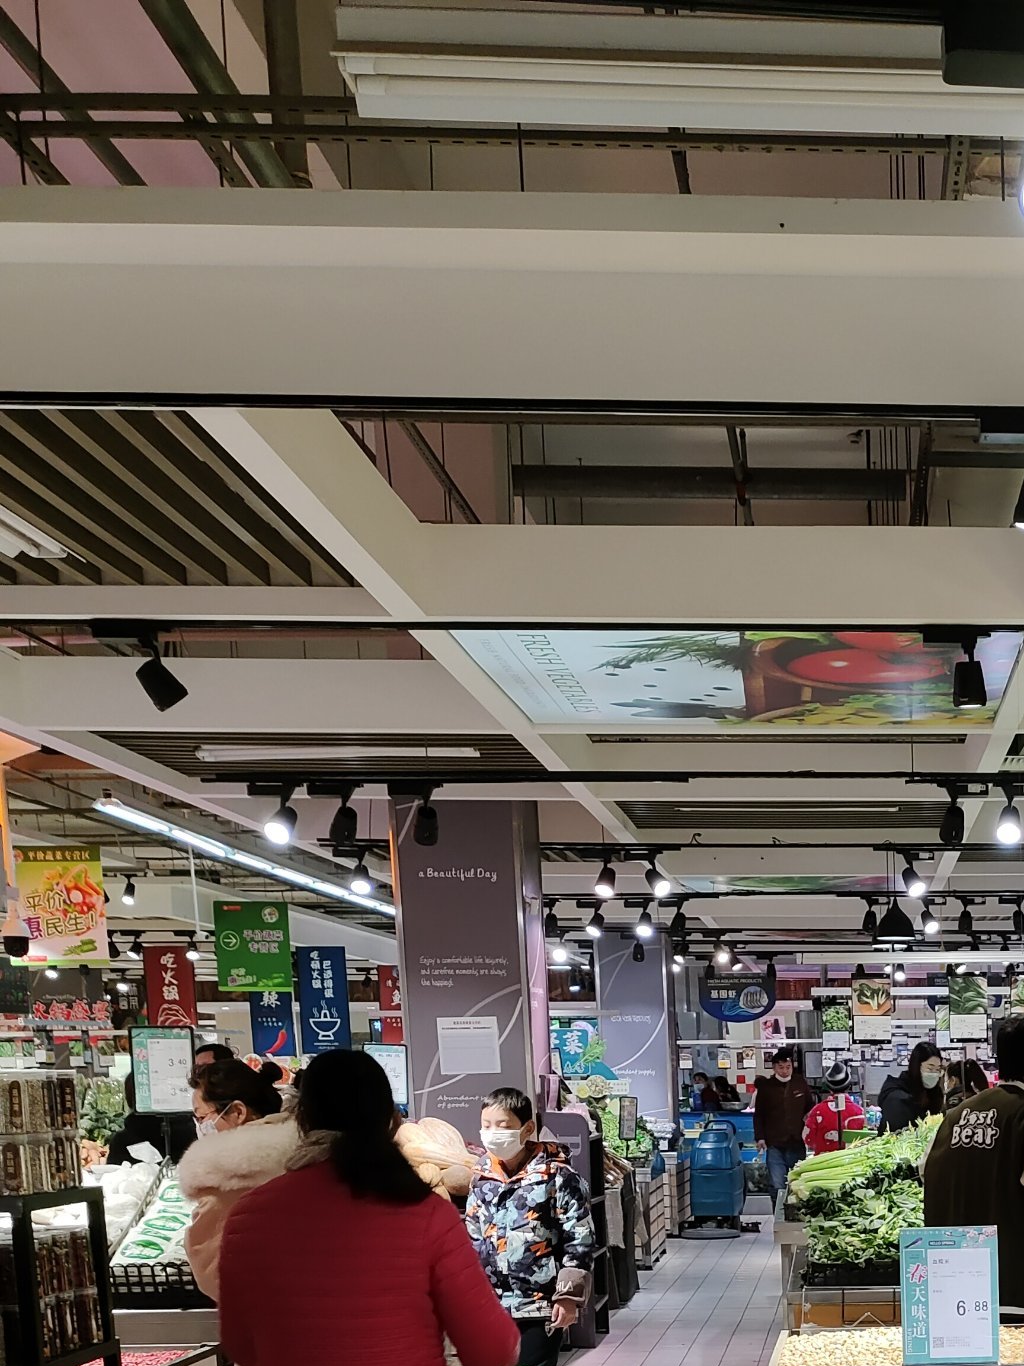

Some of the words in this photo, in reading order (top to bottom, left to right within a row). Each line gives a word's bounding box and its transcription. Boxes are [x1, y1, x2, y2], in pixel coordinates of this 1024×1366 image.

[427, 868, 475, 881] Beautiful
[477, 868, 497, 882] Day
[25, 891, 65, 912] 平价
[160, 953, 179, 1000] 吃火锅
[958, 1108, 997, 1128] Lost
[951, 1125, 999, 1148] Bear
[906, 1263, 928, 1338] 春天味道
[957, 1300, 988, 1316] 6.88
